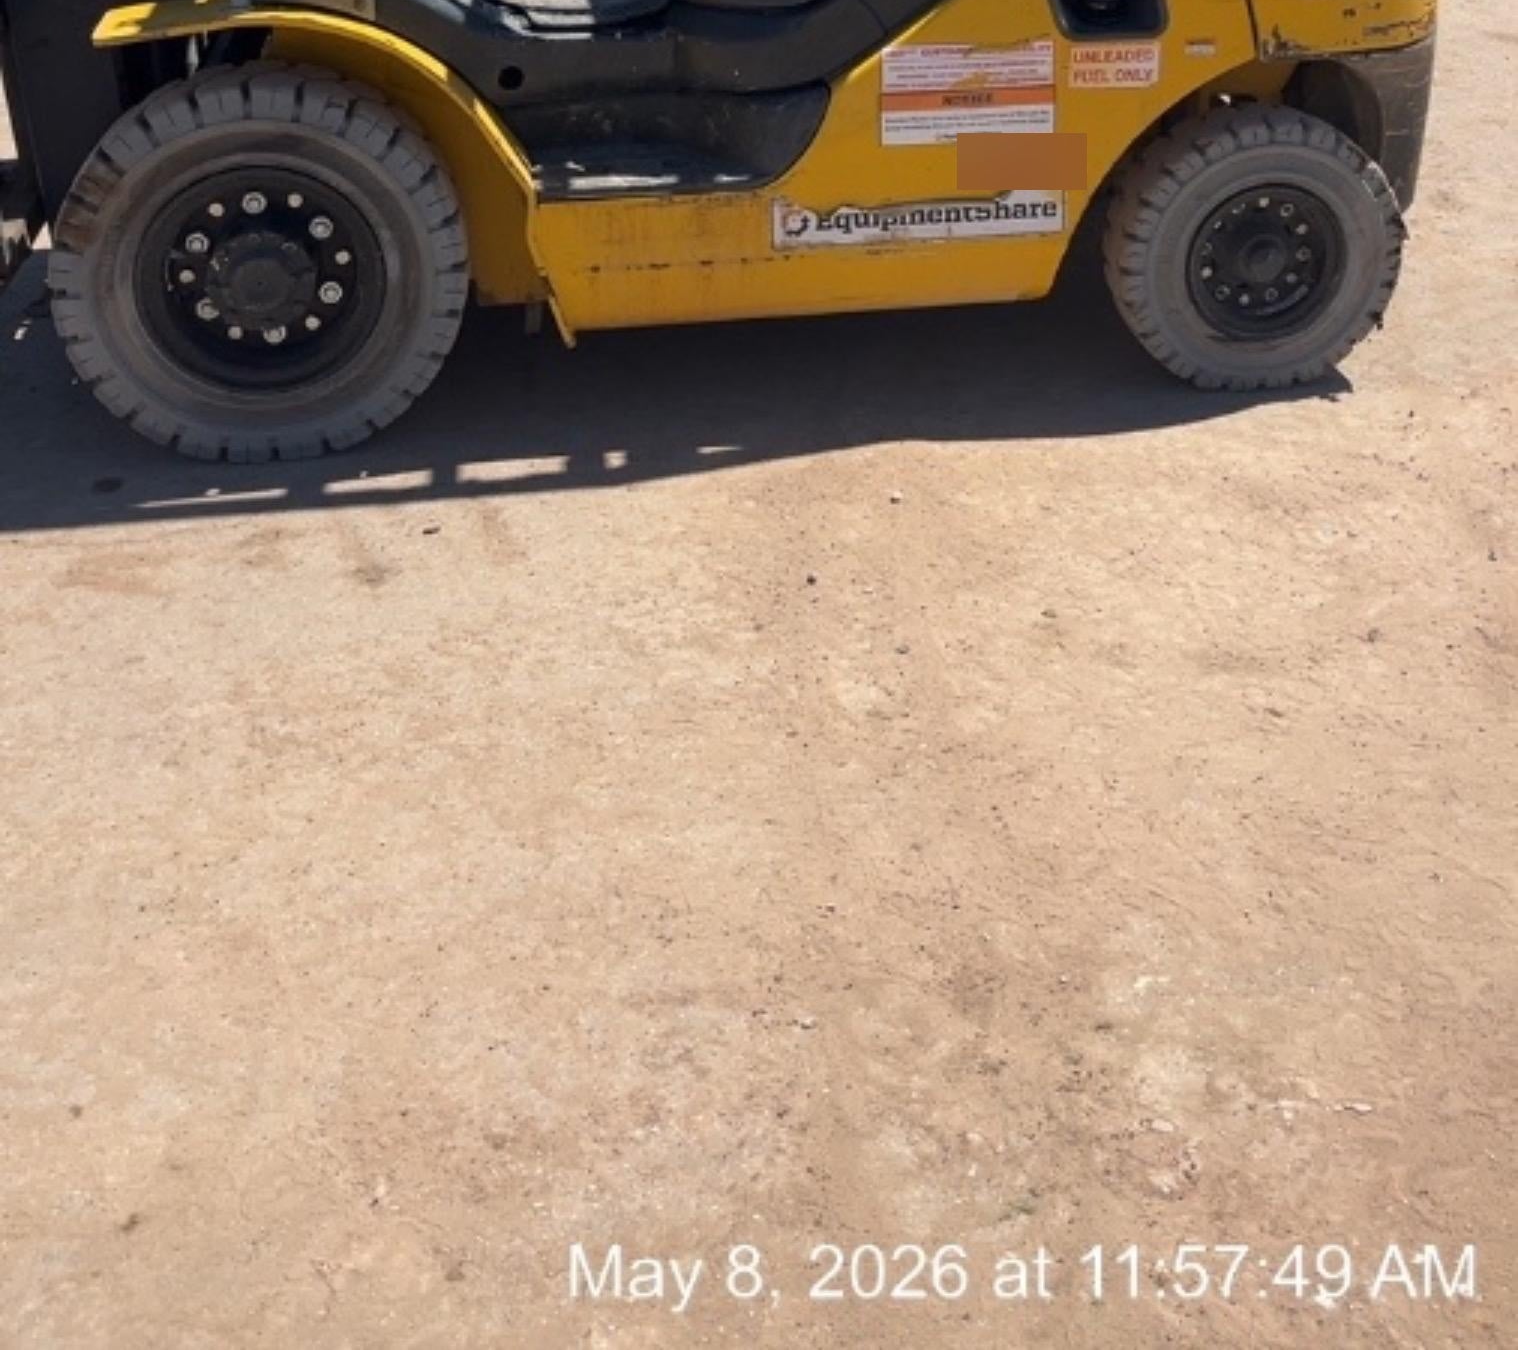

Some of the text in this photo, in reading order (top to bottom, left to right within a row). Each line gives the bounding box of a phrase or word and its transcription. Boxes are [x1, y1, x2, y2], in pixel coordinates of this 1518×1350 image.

[1073, 48, 1154, 63] UNLEADED
[1073, 68, 1154, 83] FUEL ONLY
